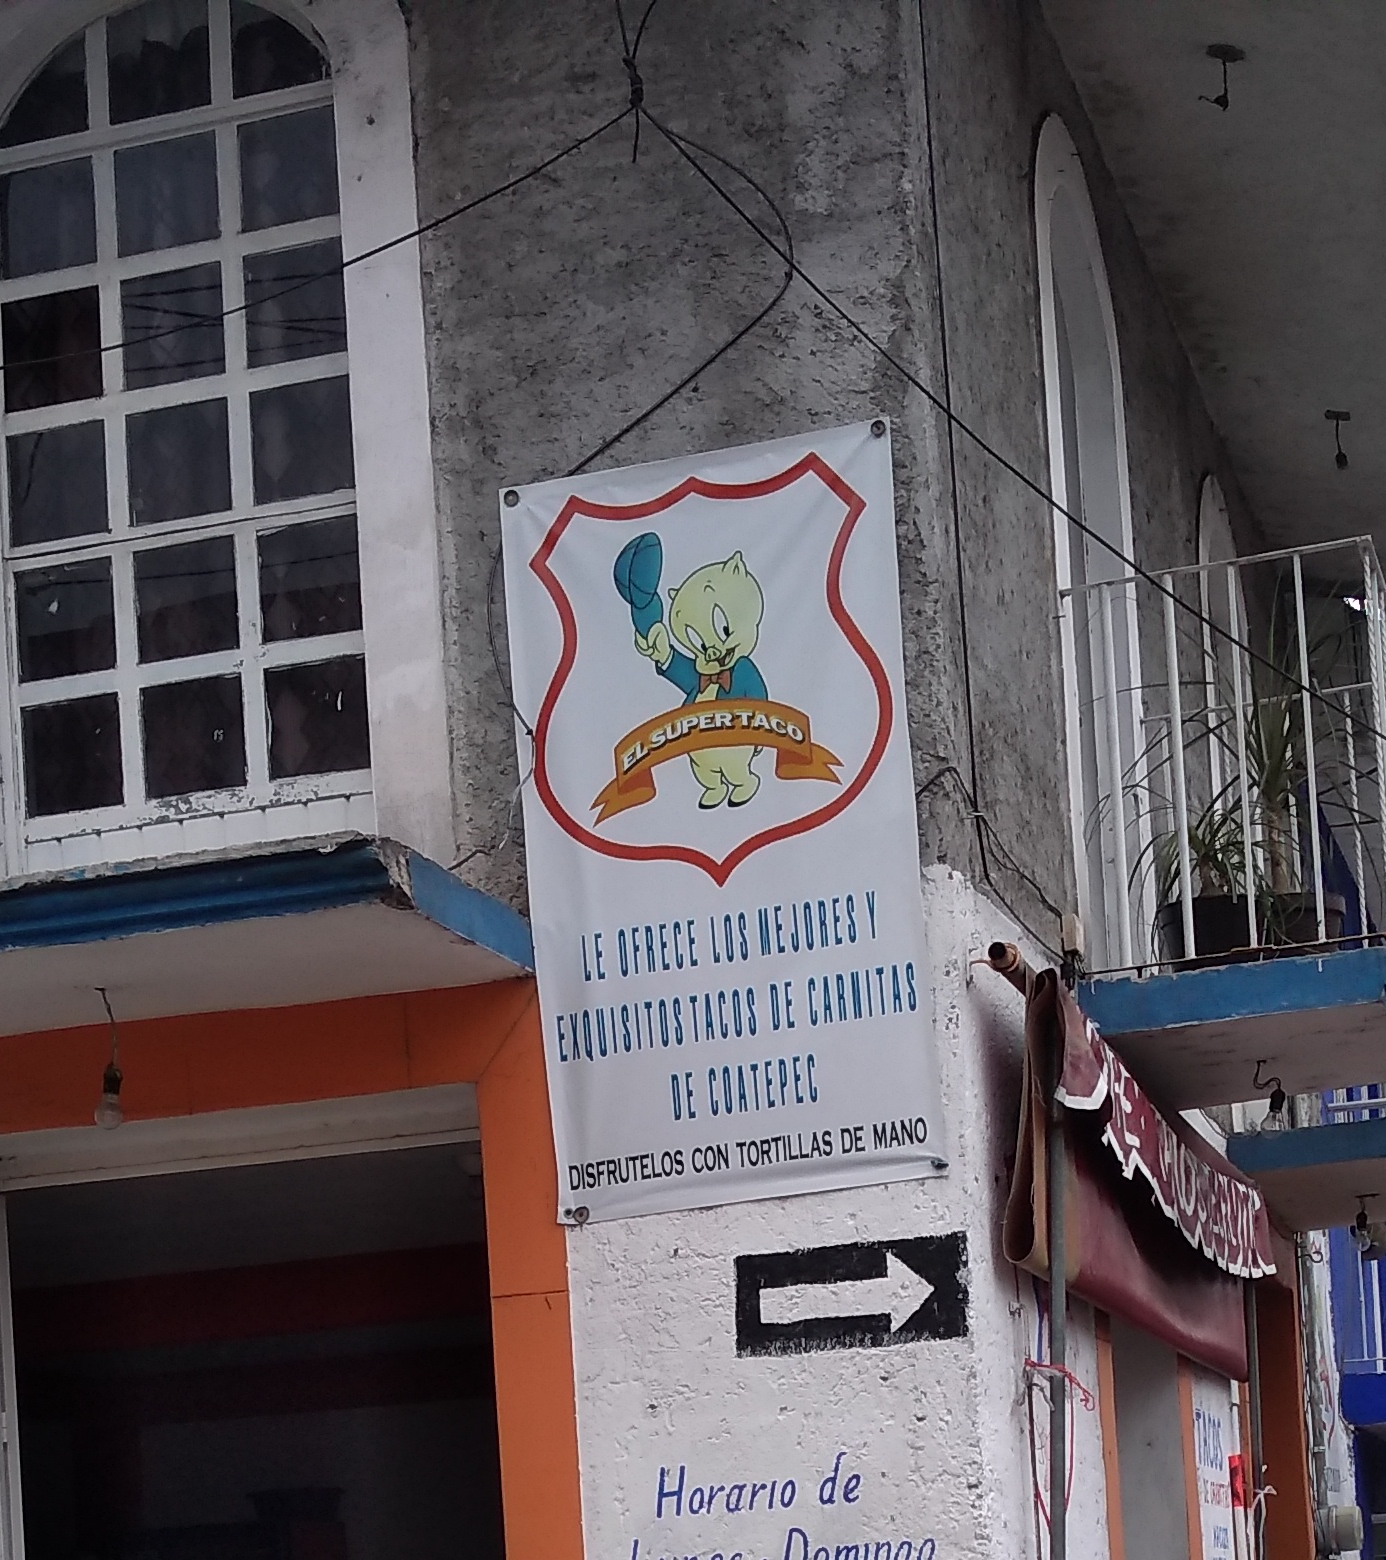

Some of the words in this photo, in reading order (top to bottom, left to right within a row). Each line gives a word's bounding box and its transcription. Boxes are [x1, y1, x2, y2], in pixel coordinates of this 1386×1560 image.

[621, 740, 651, 775] EL
[650, 710, 736, 749] SUPER
[734, 710, 807, 743] TACO
[581, 932, 606, 982] LE
[617, 918, 700, 978] OFRECE
[709, 911, 750, 964] LOS
[757, 893, 858, 957] MEJORES
[865, 890, 878, 940] Y
[556, 995, 684, 1062] EXQUISITOS
[689, 986, 758, 1043] TACOS
[769, 980, 796, 1031] DE
[807, 961, 918, 1027] CARNITAS
[670, 1071, 697, 1121] DE
[708, 1053, 819, 1117] COATEPEC
[568, 1148, 685, 1192] DISFRUTELOS
[690, 1144, 731, 1175] CON
[735, 1130, 833, 1169] TORTILLAS
[840, 1124, 867, 1155] DE
[872, 1116, 928, 1151] MANO
[1196, 1408, 1223, 1471] TACOS
[655, 1464, 797, 1518] Horario
[818, 1451, 862, 1505] de
